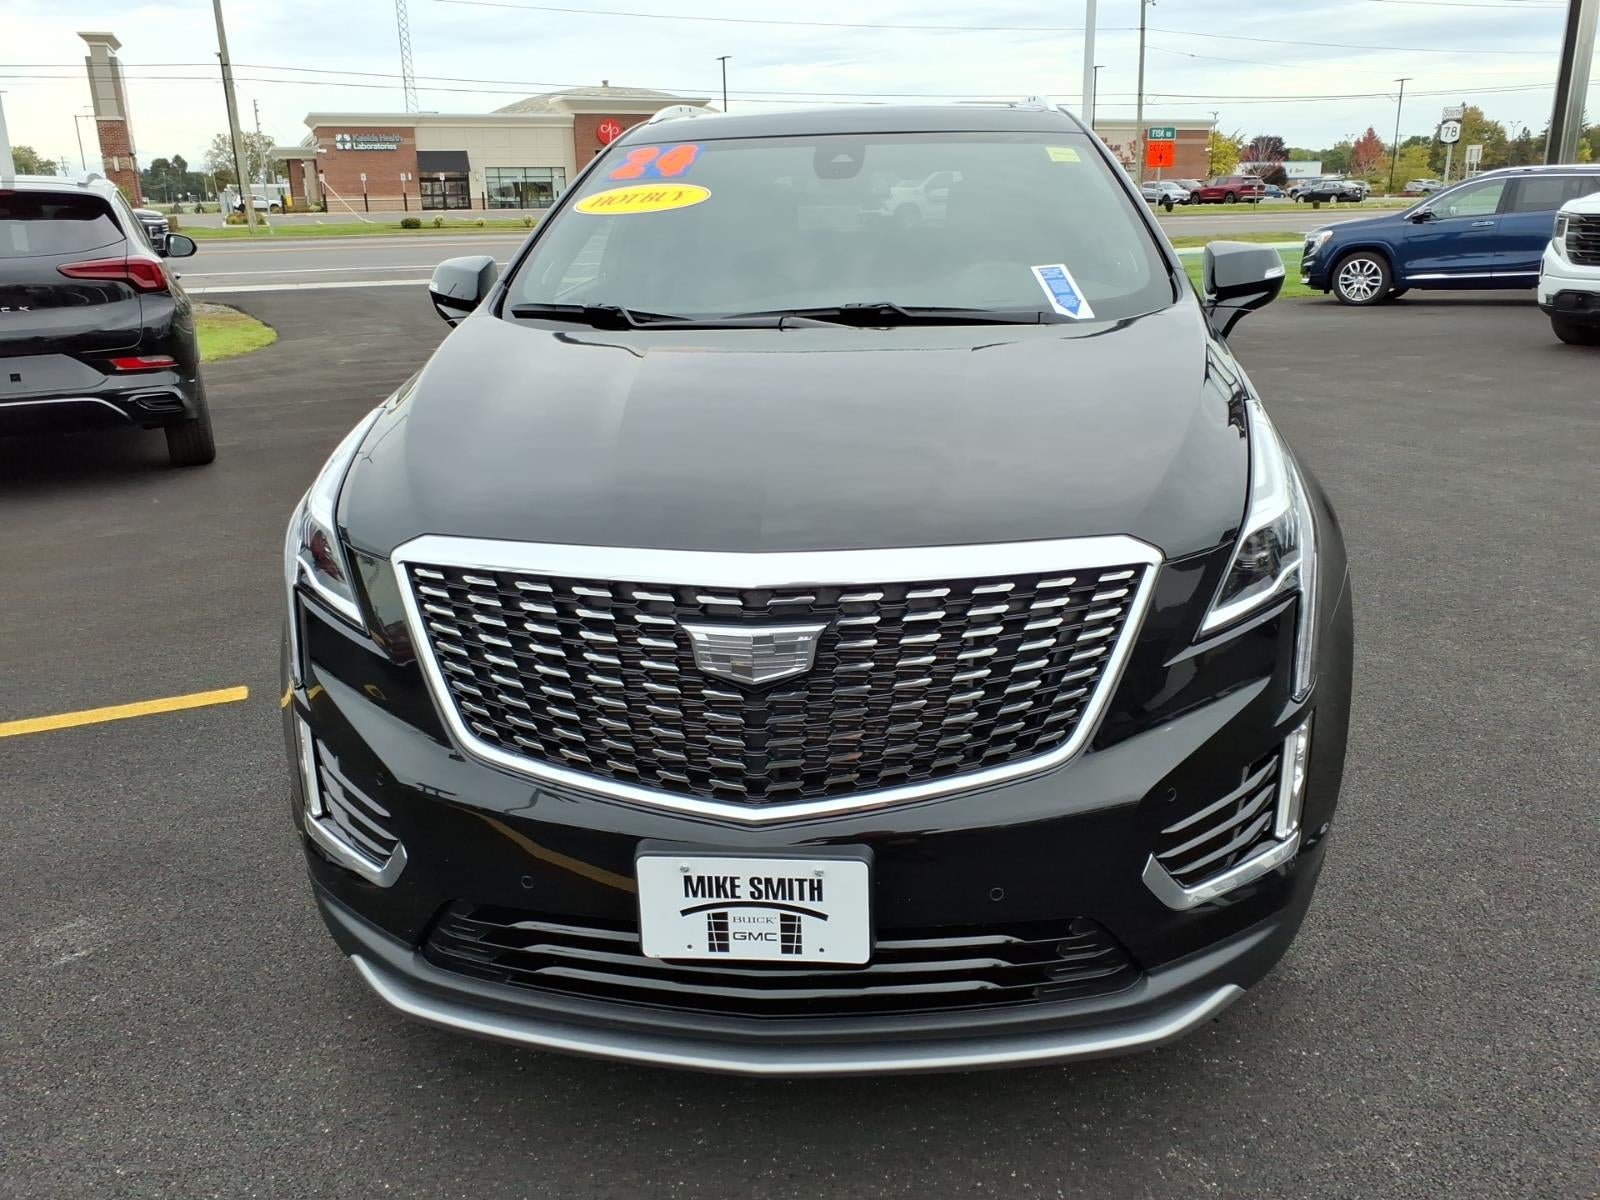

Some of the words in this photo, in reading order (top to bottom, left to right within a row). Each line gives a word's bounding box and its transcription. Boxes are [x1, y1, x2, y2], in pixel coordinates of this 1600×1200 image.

[1444, 109, 1462, 117] SOUTH
[1152, 129, 1165, 137] FISK
[1444, 126, 1457, 138] 78
[353, 142, 397, 150] Laboratories
[683, 874, 742, 899] MIKE
[748, 876, 824, 902] SMITH
[732, 915, 775, 924] BUICK
[732, 931, 778, 942] GMC
